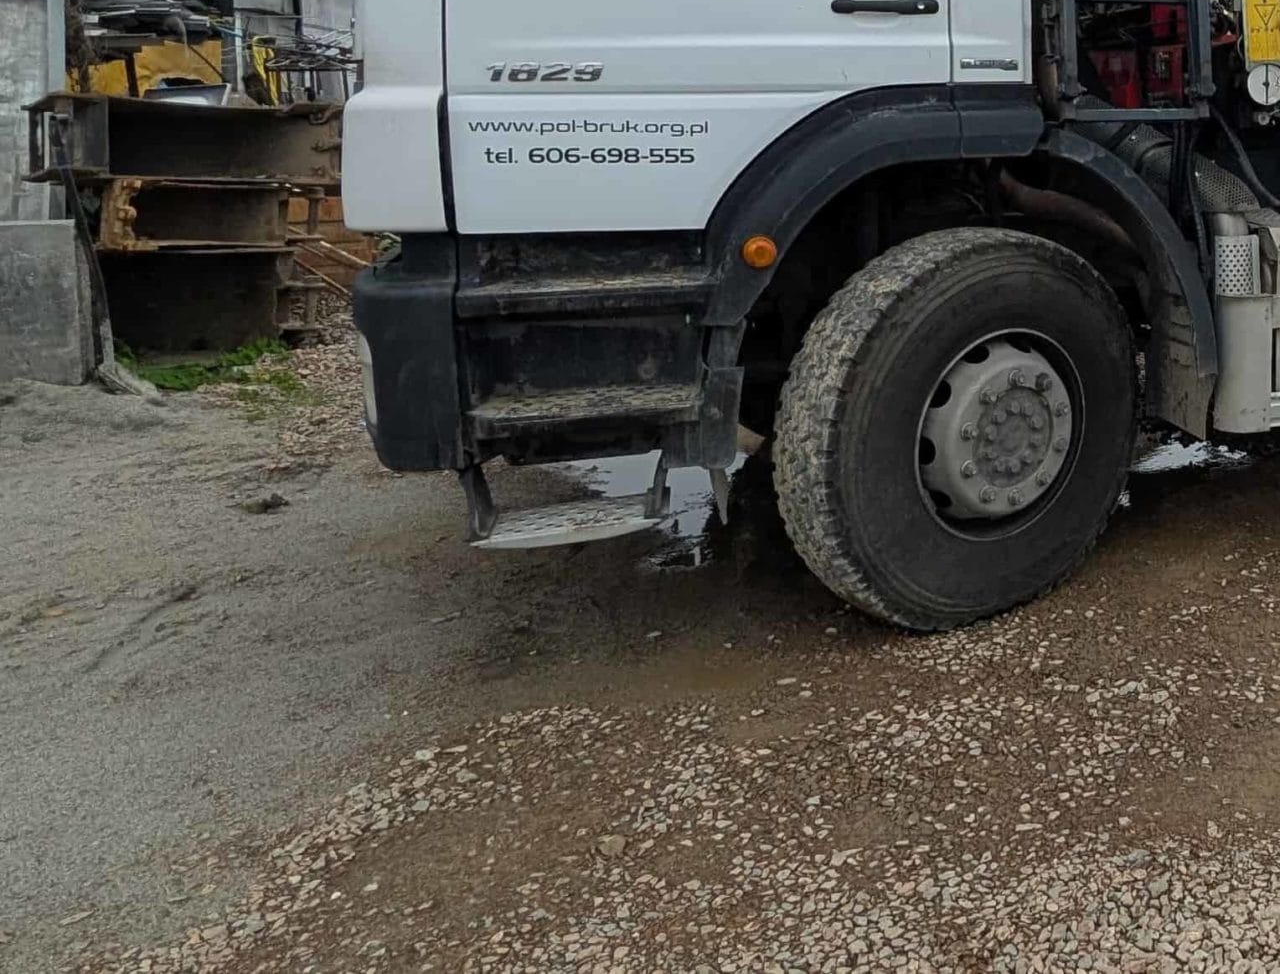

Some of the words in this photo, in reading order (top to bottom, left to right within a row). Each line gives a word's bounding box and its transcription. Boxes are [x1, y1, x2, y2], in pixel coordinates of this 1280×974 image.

[468, 120, 709, 138] www.pol-bruk.org.pl
[485, 147, 519, 164] tel.
[528, 148, 695, 164] 606-698-555
